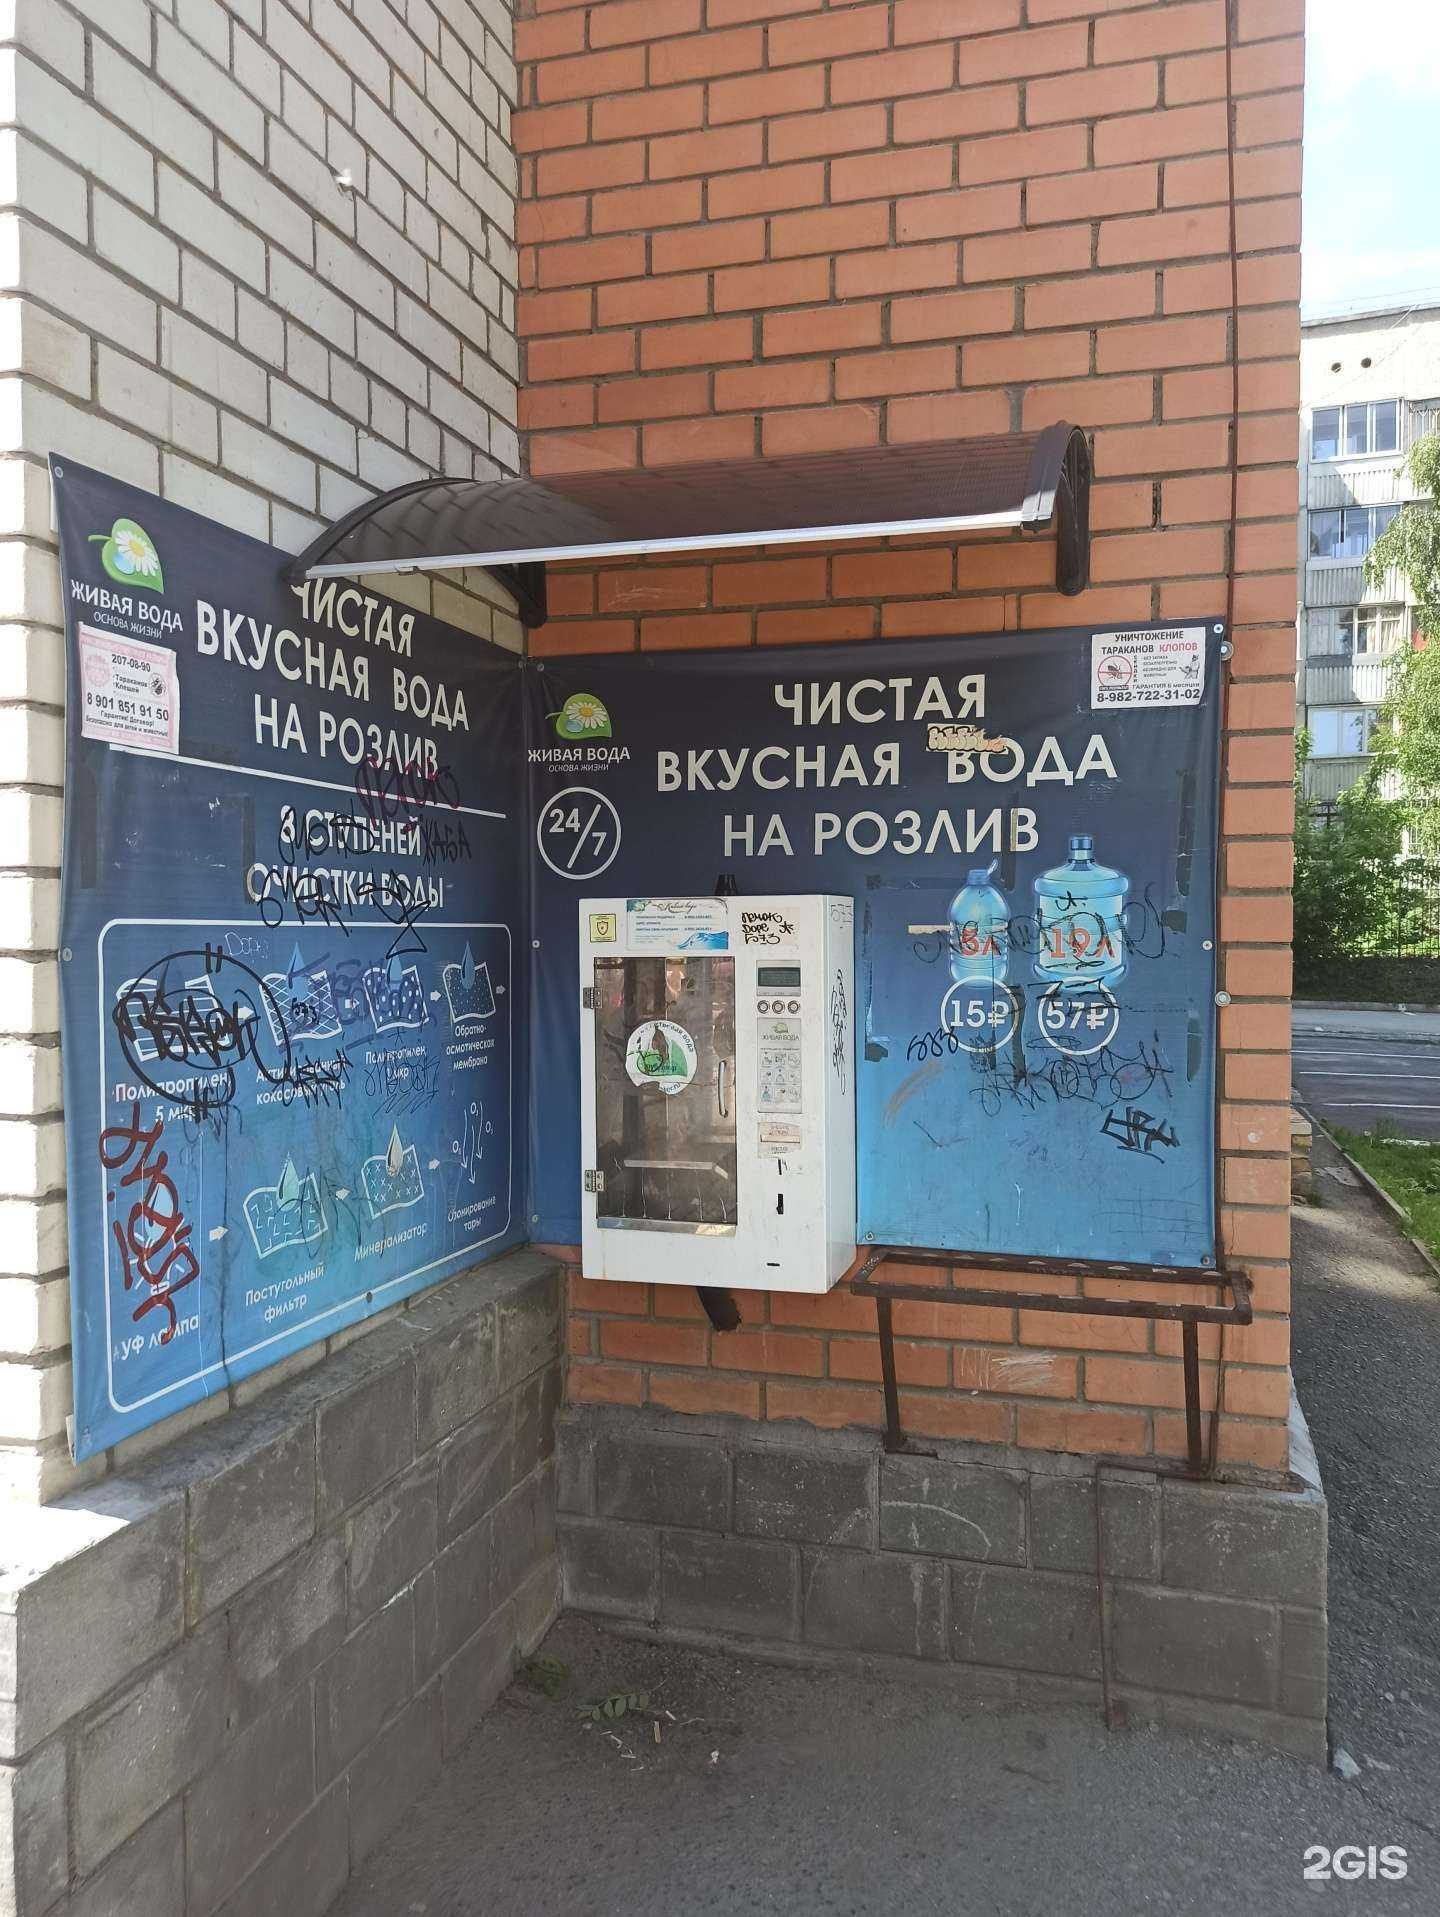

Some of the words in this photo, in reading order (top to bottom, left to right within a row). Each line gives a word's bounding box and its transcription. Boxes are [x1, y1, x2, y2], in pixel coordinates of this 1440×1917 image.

[71, 579, 133, 617] ЖИВАЯ
[138, 602, 184, 632] ВОДА
[290, 577, 416, 657] ЧИСТАЯ
[93, 611, 129, 630] ОСНОВА
[130, 622, 162, 639] ЖИЗНИ
[1115, 630, 1184, 642] УНИЧТОЖЕНИЕ
[111, 654, 151, 673] 207-08-90
[1101, 644, 1154, 655] ТАРАКАНОВ
[1159, 642, 1198, 653] КЛОПОВ
[196, 599, 370, 702] ВКУСНАЯ
[393, 667, 470, 731] ВОДА
[87, 692, 93, 705] 8
[96, 694, 114, 709] 901
[118, 701, 136, 715] 851
[140, 705, 151, 718] 91
[156, 709, 169, 721] 50
[774, 674, 986, 726] ЧИСТАЯ
[1097, 688, 1200, 703] 8-982-722-31-02
[254, 693, 308, 754] НА
[319, 710, 439, 780] РОЗЛИВ
[528, 748, 582, 763] ЖИВАЯ
[587, 747, 631, 763] ВОДА
[548, 764, 579, 772] ОСНОВА
[580, 763, 609, 771] ЖИЗНИ
[656, 742, 900, 792] ВКУСНАЯ
[947, 734, 1119, 788] ВОДА
[305, 808, 422, 857] СТУПЕНЕЙ
[549, 803, 607, 869] 24/7
[723, 813, 795, 857] НА
[814, 807, 1040, 856] РОЗЛИВ
[246, 862, 374, 906] ОЧИСТКИ
[381, 872, 444, 911] ВОДЫ
[1050, 927, 1116, 959] 19л
[446, 1039, 495, 1055] осмотическая
[155, 1105, 164, 1122] 5
[447, 1195, 497, 1222] Озонирование
[463, 1216, 482, 1232] тары
[354, 1222, 428, 1263] Минерализатор
[245, 1261, 325, 1307] Постугольный
[264, 1294, 308, 1324] фильтр
